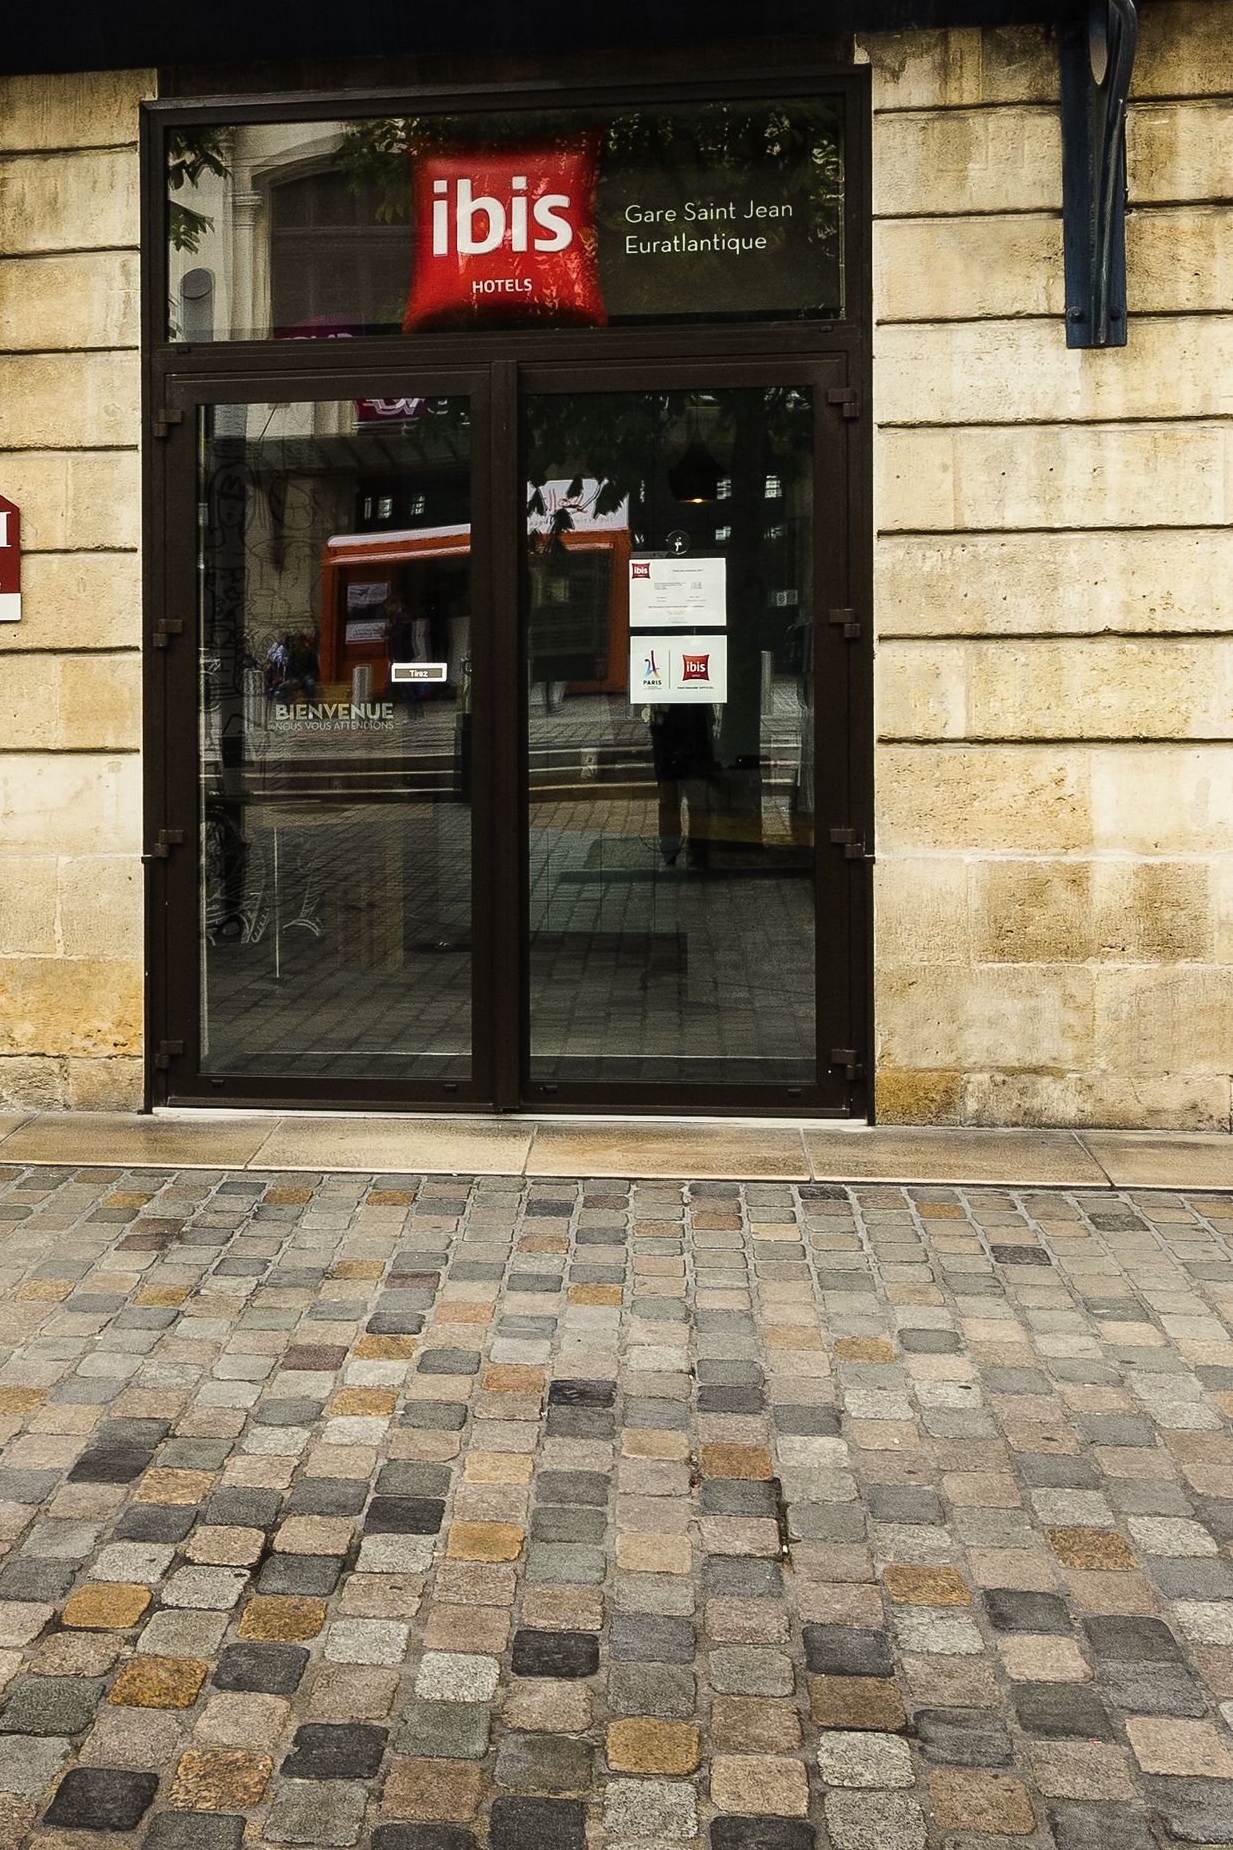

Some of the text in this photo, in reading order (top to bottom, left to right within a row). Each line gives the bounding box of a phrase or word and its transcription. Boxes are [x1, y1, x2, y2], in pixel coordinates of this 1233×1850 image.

[432, 175, 574, 258] ibis
[624, 199, 794, 224] Gare Saint Jean
[624, 232, 768, 256] Euratlantique
[471, 278, 534, 294] HOTELS
[633, 566, 648, 575] ibis
[685, 660, 707, 673] ibis
[274, 702, 395, 721] BIENVENUE
[274, 720, 395, 731] NOUS VOUS ATTENDIONS
